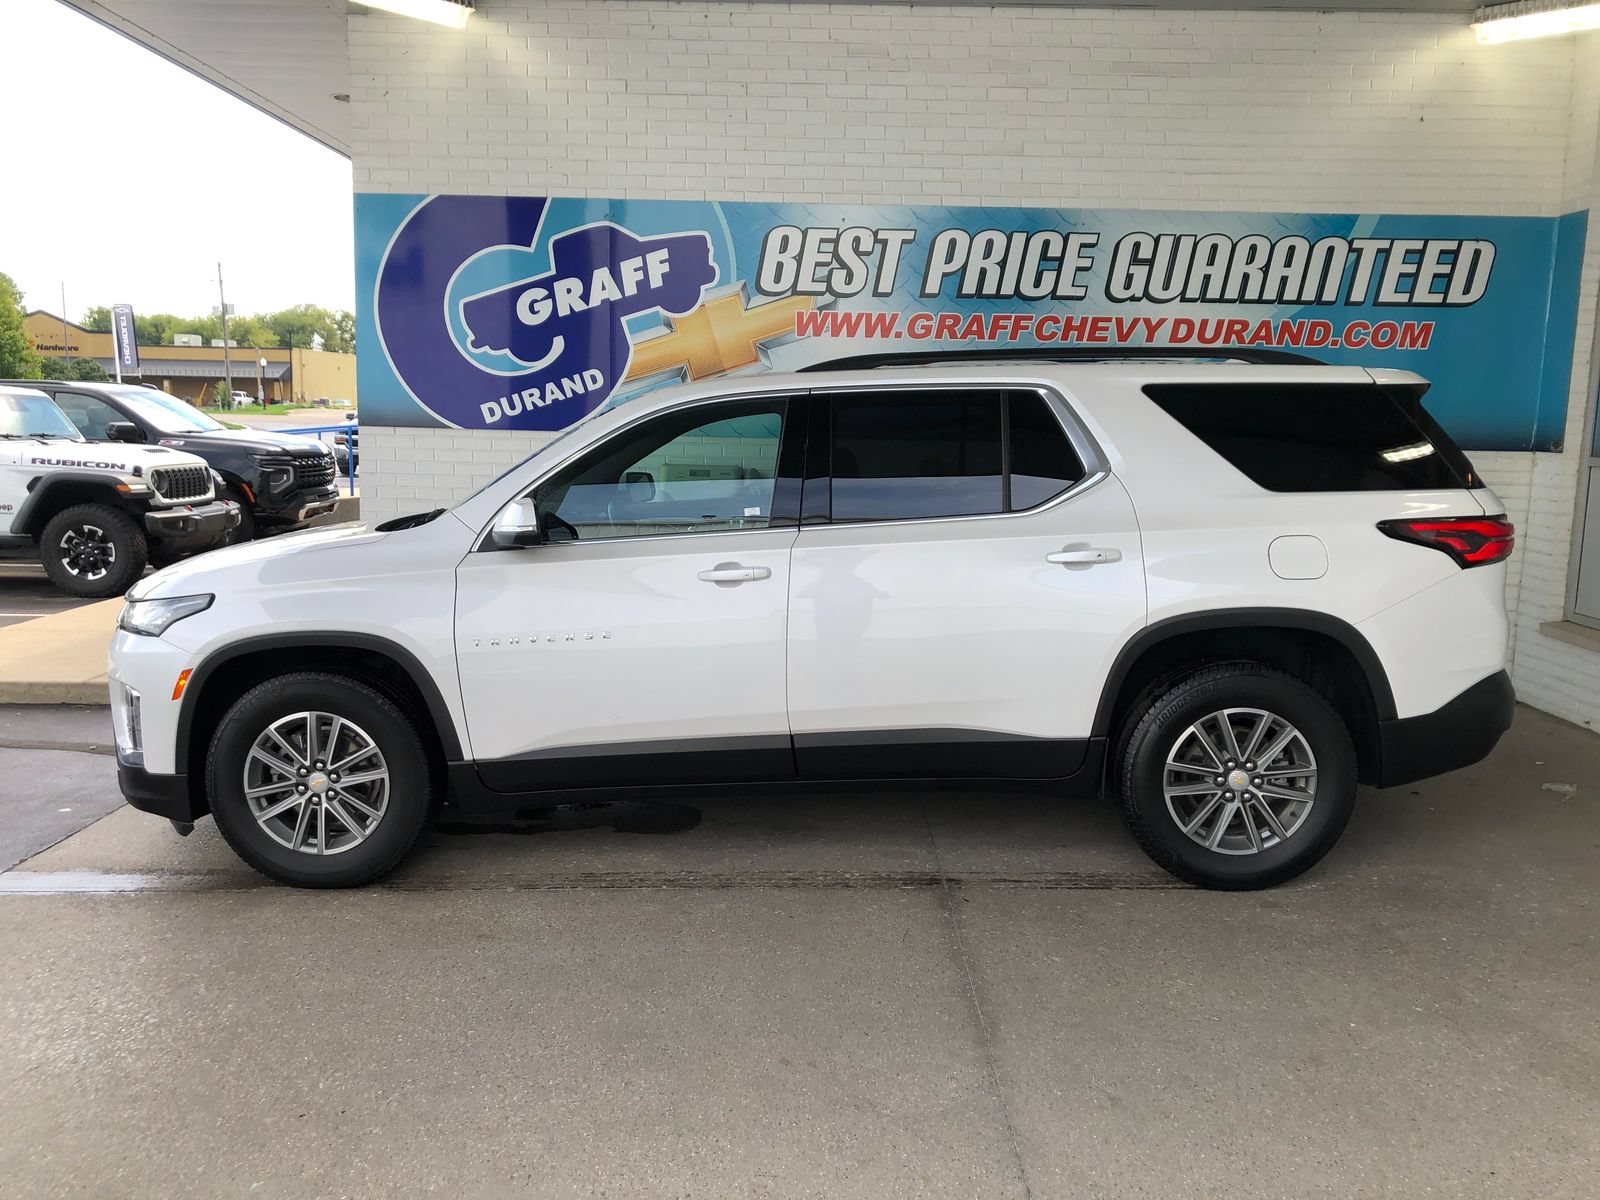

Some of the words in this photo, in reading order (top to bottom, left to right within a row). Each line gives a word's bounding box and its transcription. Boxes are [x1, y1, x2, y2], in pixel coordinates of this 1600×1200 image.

[516, 249, 670, 326] GRAFF
[757, 225, 915, 297] BEST
[921, 228, 1099, 300] PRICE
[1104, 231, 1496, 307] GUARANTEED
[479, 368, 605, 425] DURAND
[31, 457, 126, 470] RUBICON
